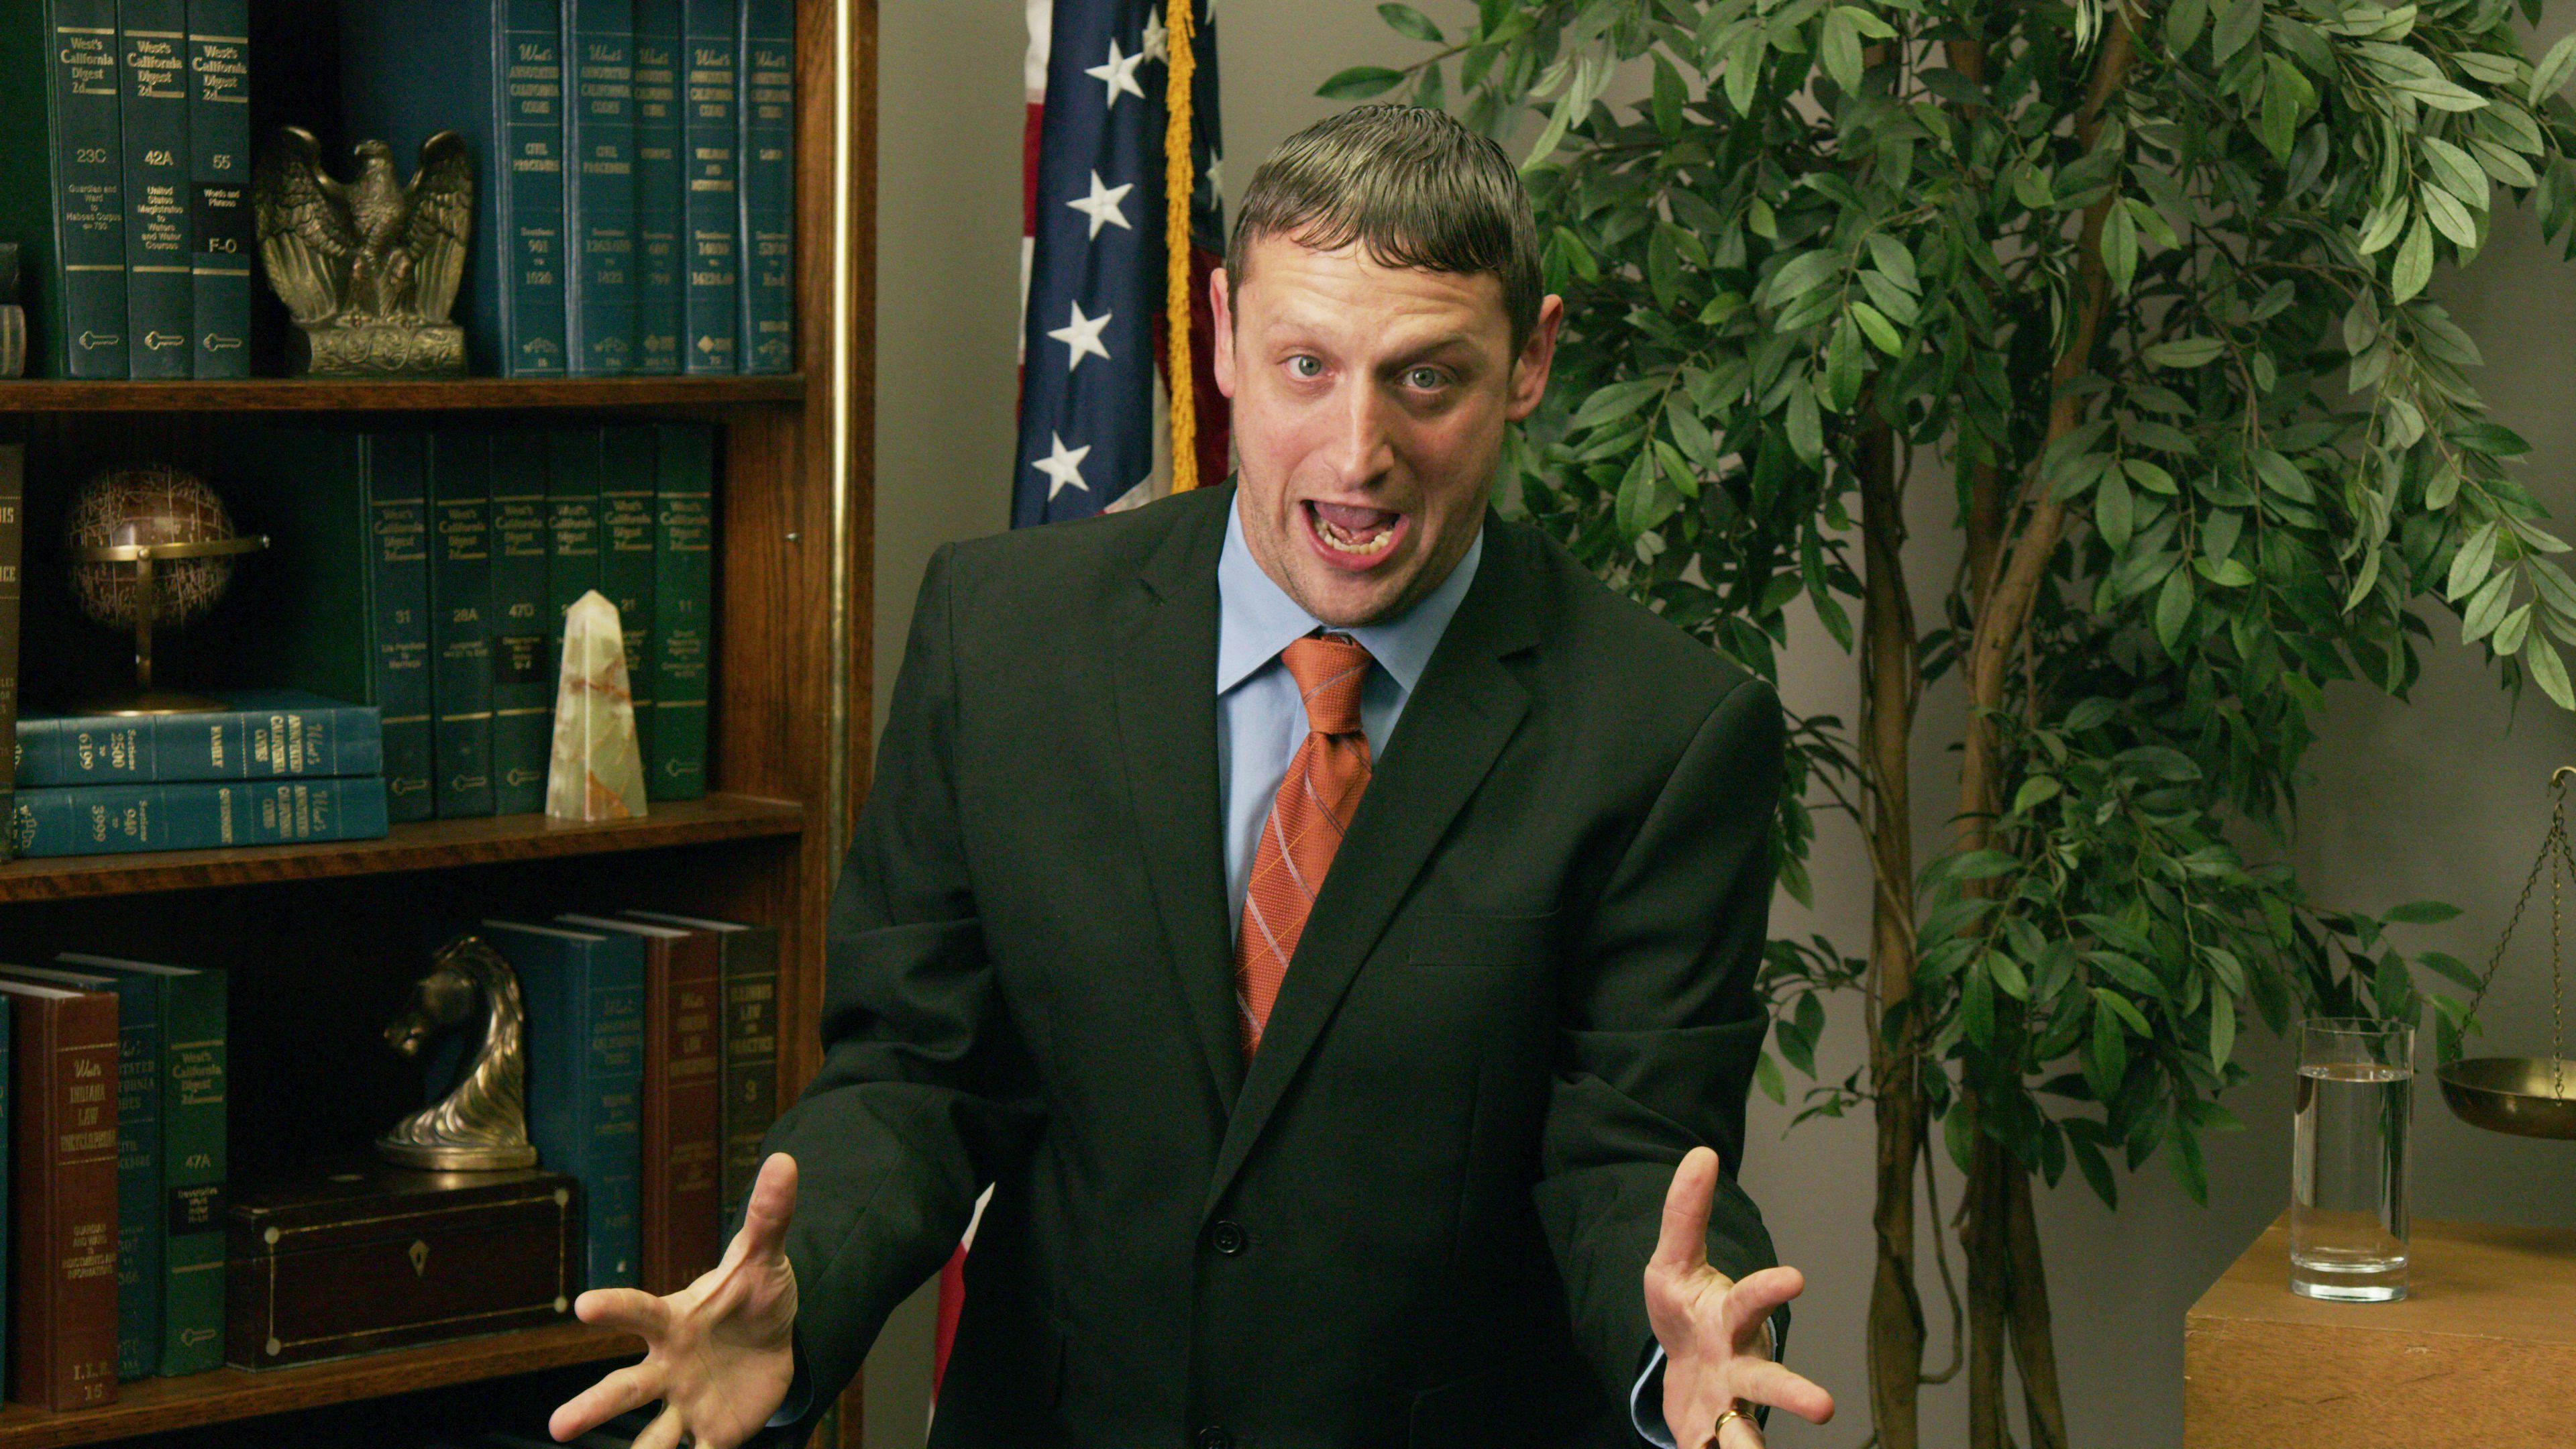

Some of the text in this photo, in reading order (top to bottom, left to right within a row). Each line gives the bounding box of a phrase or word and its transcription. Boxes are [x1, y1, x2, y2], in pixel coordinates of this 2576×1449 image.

[70, 37, 103, 50] West's
[137, 41, 171, 54] West's
[60, 50, 113, 66] California
[204, 46, 238, 58] West's
[127, 53, 182, 69] California
[192, 58, 247, 74] California
[72, 68, 104, 80] Digest
[139, 71, 172, 84] Digest
[204, 74, 238, 88] Digest
[72, 82, 85, 93] 2d
[138, 85, 152, 97] 2d
[203, 89, 217, 101] 2d
[76, 148, 107, 164] 23C
[144, 150, 174, 166] 42A
[213, 155, 231, 169] 55
[68, 184, 102, 193] Guardian
[147, 186, 174, 195] United
[85, 194, 103, 202] Ward
[148, 195, 174, 204] States
[208, 198, 237, 207] Phrases
[138, 204, 184, 214] Magistrates
[66, 212, 121, 223] Habeas Corpus
[157, 215, 166, 223] to
[148, 223, 176, 231] Waters
[142, 233, 157, 241] and
[145, 241, 179, 250] Courses
[209, 237, 238, 254] F-O
[111, 732, 126, 769] 2500
[127, 729, 136, 771] Sections
[211, 726, 224, 768] FAMILY
[255, 729, 269, 762] CODES
[271, 715, 286, 774] CALIFORNIA
[288, 714, 304, 773] ANNOTATED
[307, 723, 324, 765] West's
[78, 733, 94, 770] 6199
[277, 786, 293, 839] CALIFORNIA
[312, 790, 329, 832] West's
[91, 805, 106, 843] 3999
[123, 808, 138, 836] 940
[139, 800, 148, 842] Sections
[182, 1051, 212, 1063] West's
[172, 1065, 222, 1079] California
[70, 1083, 105, 1104] INDIANA
[78, 1107, 99, 1127] LAW
[60, 1130, 117, 1152] ENCYCLOPEDIA
[186, 1154, 211, 1169] 47A
